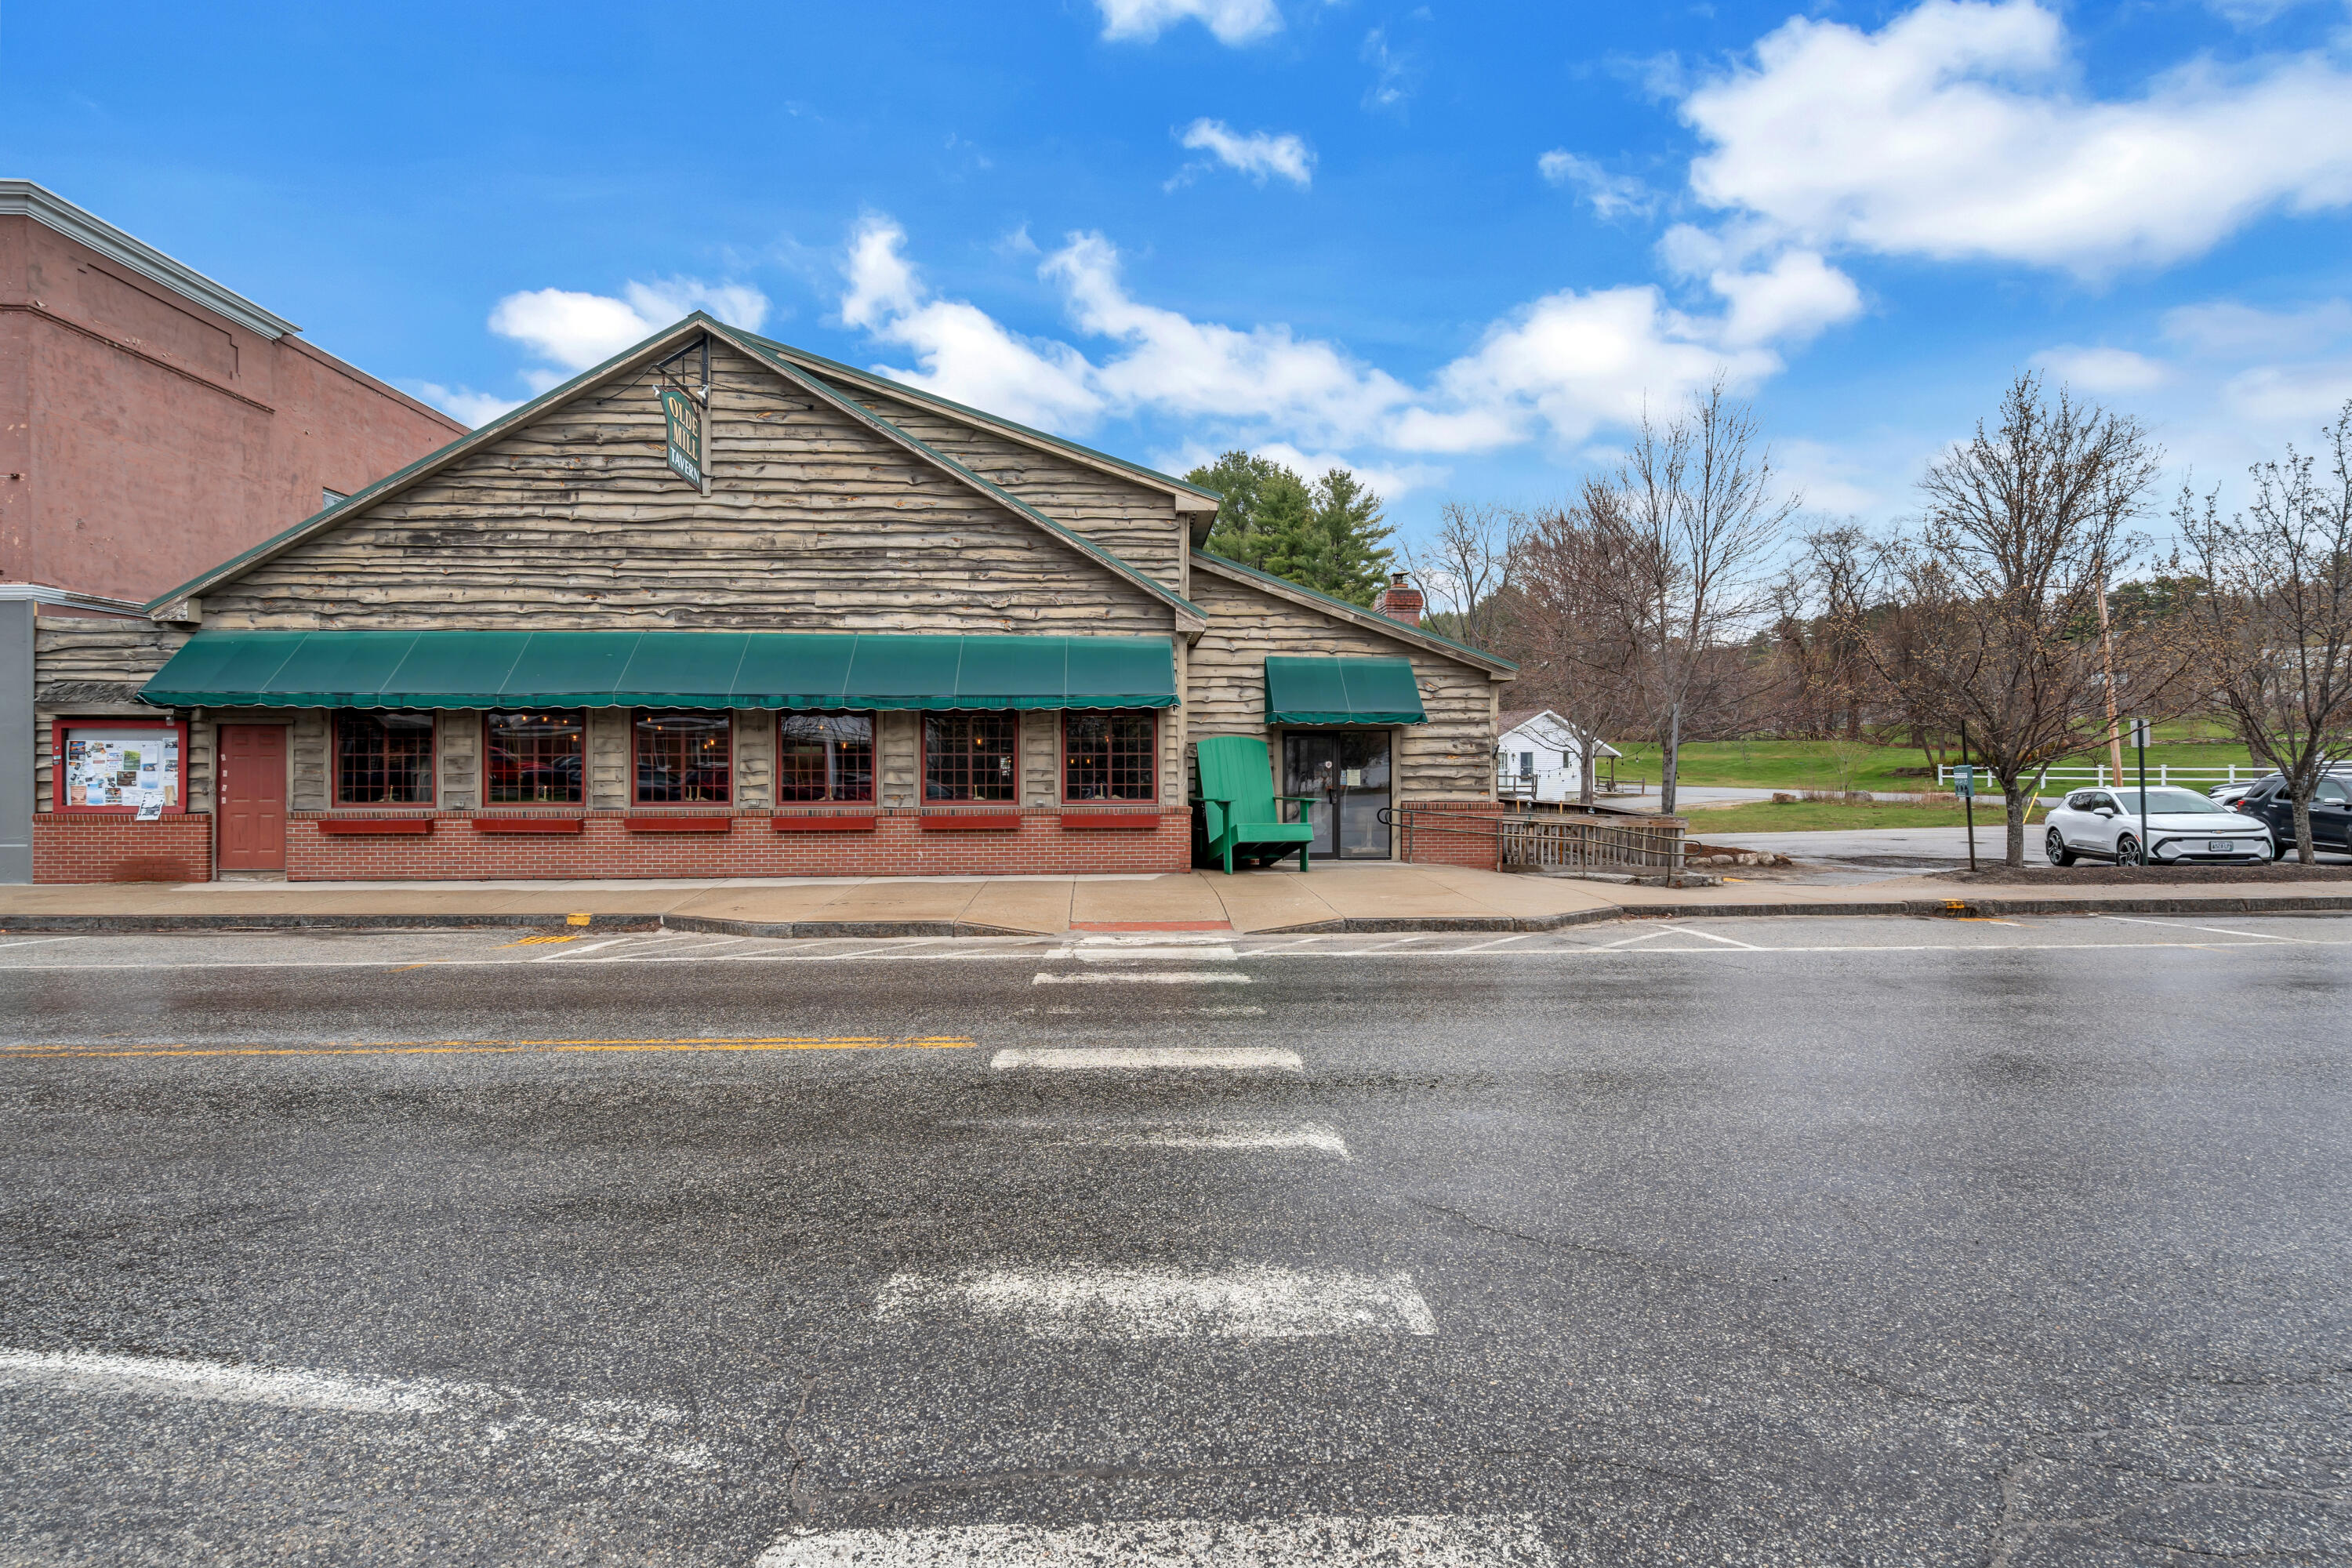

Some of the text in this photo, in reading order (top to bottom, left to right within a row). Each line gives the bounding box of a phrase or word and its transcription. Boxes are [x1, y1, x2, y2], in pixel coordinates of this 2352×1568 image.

[669, 397, 698, 437] OLDE
[673, 421, 698, 462] MILL
[670, 447, 699, 484] TAVERN
